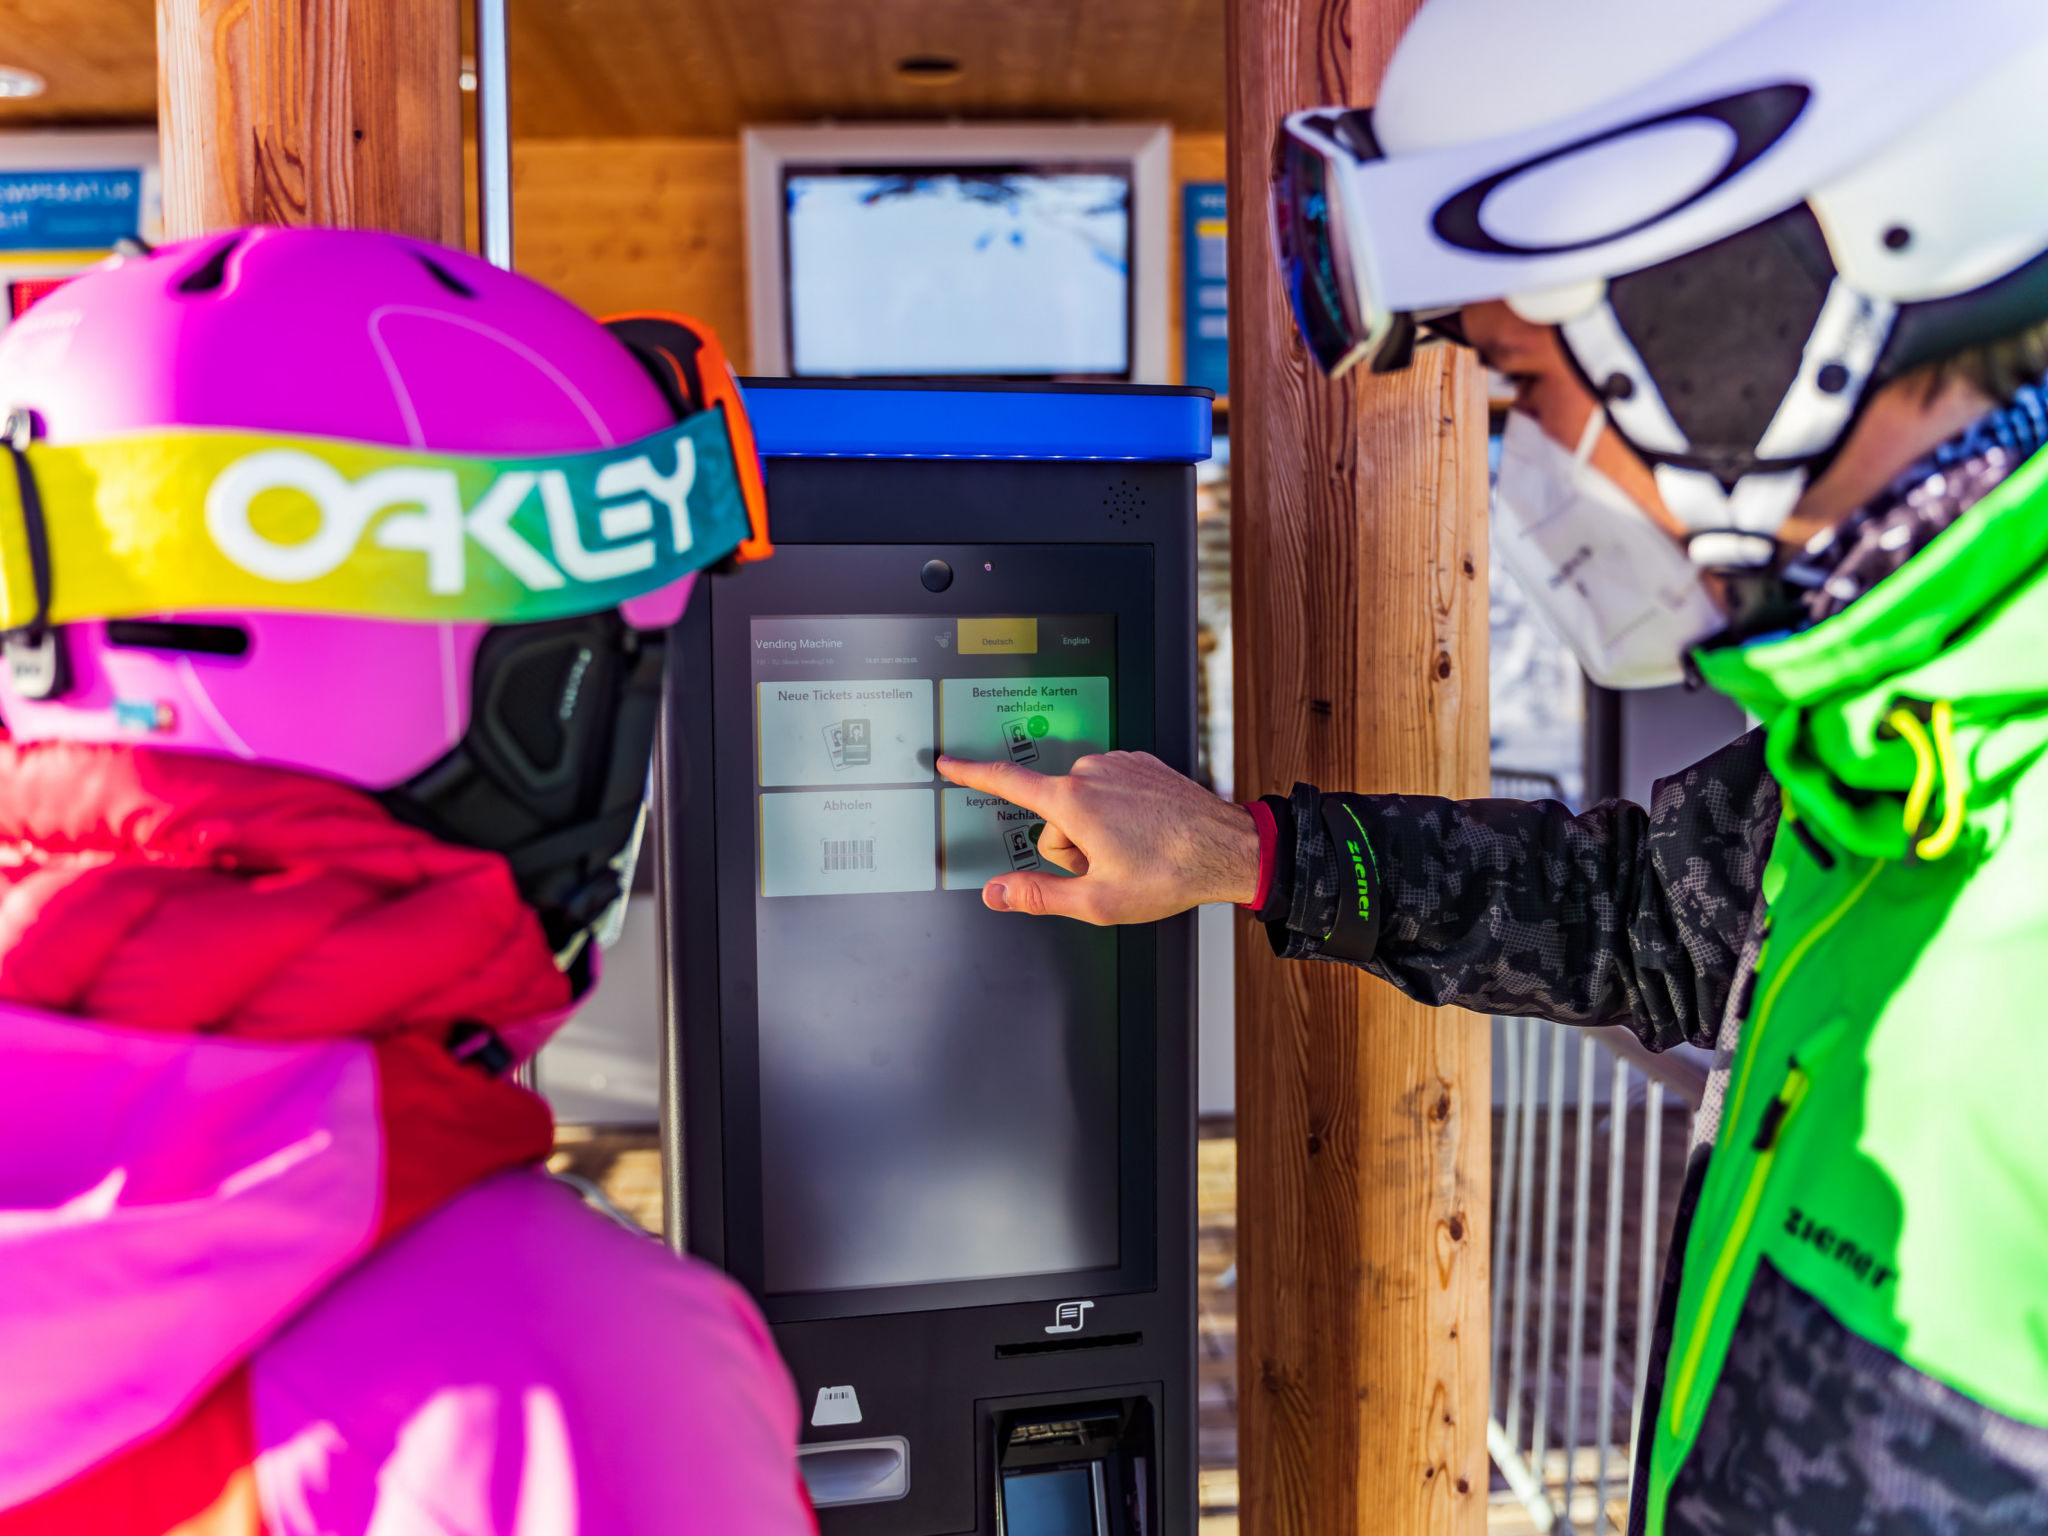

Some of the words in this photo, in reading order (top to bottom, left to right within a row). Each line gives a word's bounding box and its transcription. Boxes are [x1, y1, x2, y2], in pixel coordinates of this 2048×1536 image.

[205, 437, 696, 595] OAKLEY
[755, 638, 797, 651] Vending
[800, 637, 843, 649] Machine
[982, 637, 1013, 646] Deutsch
[1062, 636, 1090, 647] English
[778, 690, 809, 701] Neue
[812, 688, 852, 701] Tickets
[856, 688, 913, 701] ausstellen
[972, 686, 1037, 698] Bestehende
[1041, 686, 1078, 697] Karten
[997, 700, 1054, 713] nachladen
[823, 799, 872, 811] Abholen
